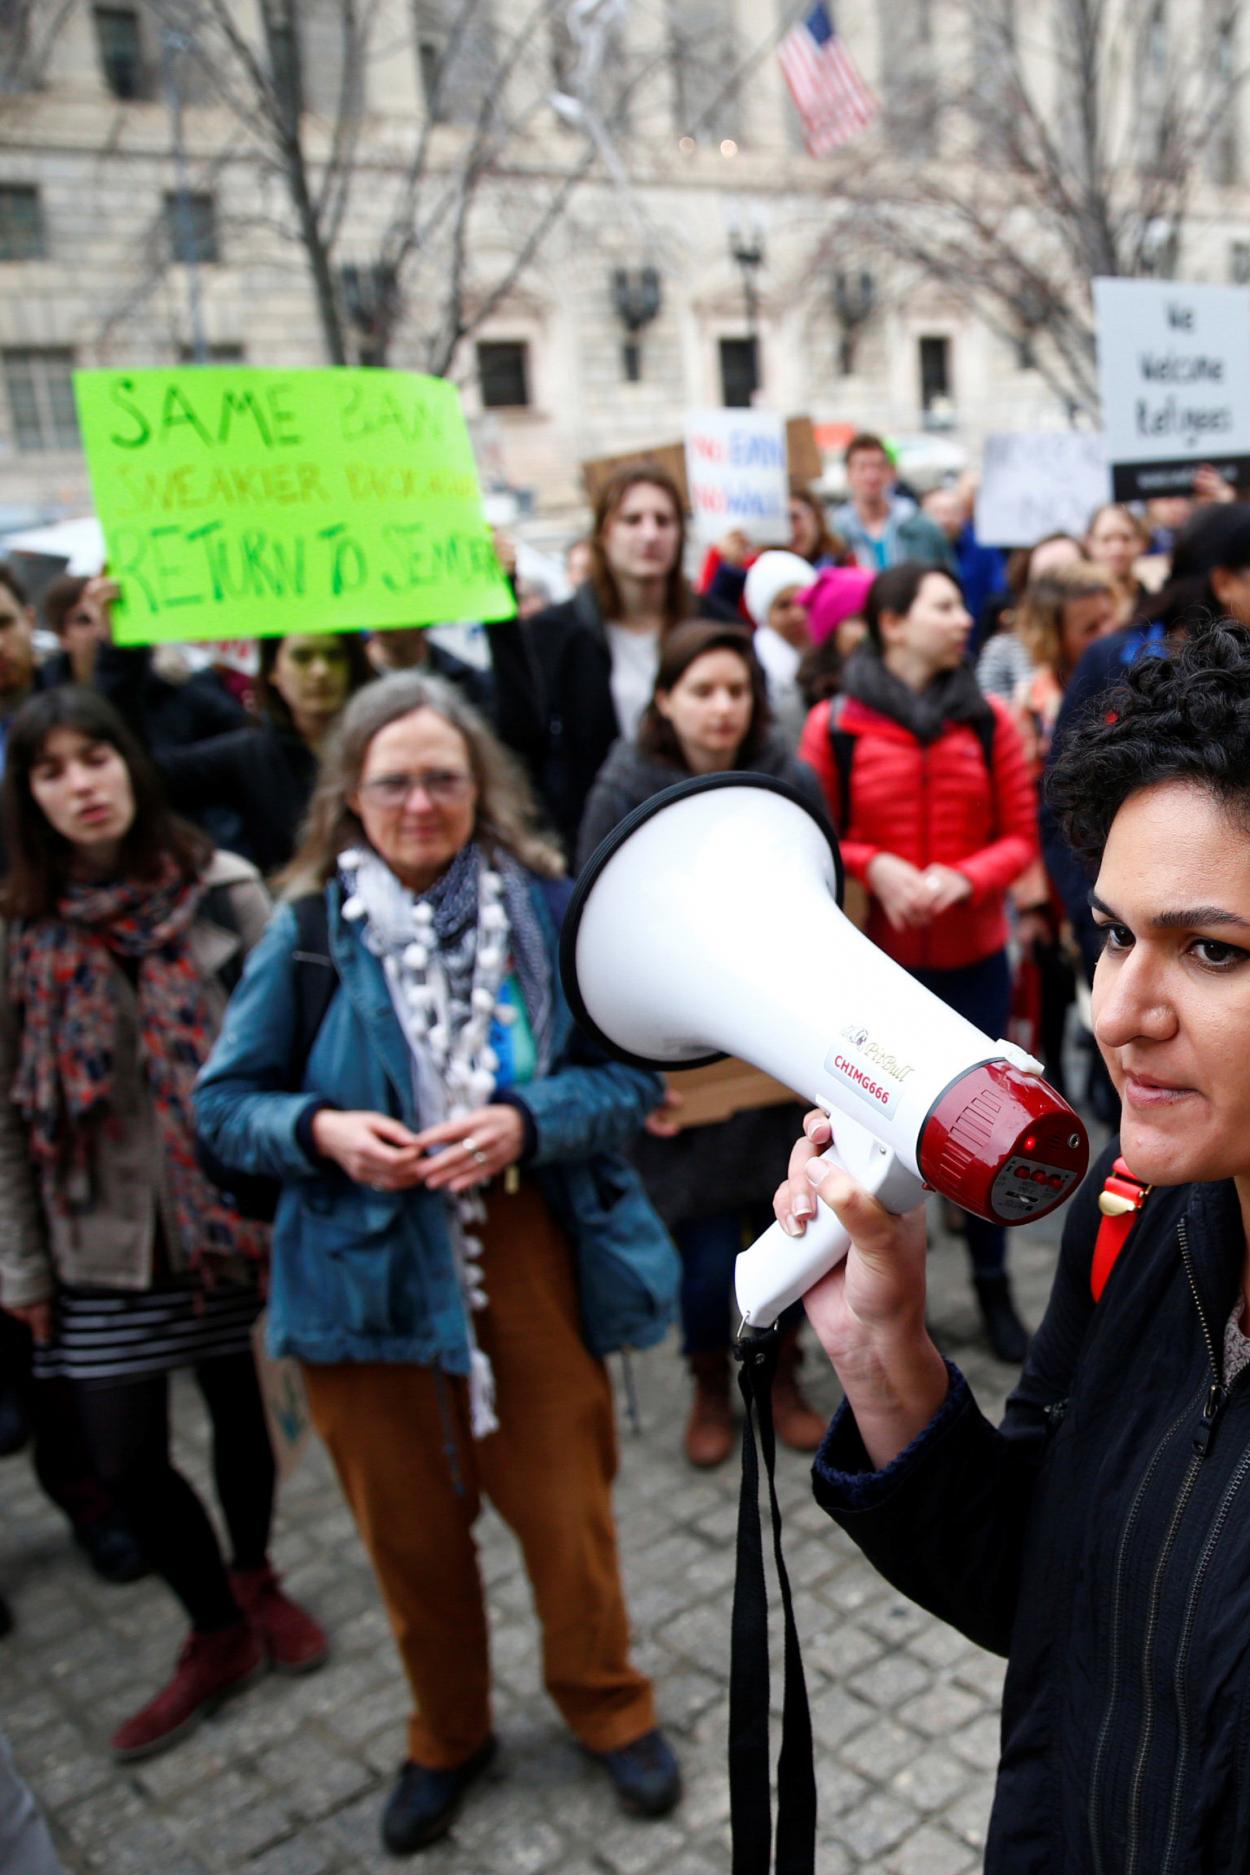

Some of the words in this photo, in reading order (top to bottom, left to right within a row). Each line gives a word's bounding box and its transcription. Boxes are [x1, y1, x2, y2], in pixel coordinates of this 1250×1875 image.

[1164, 303, 1195, 335] We
[1138, 353, 1224, 385] Welcome
[110, 378, 301, 449] SAME
[338, 382, 444, 442] BAN
[1134, 397, 1233, 445] Refugees
[110, 520, 306, 614] RETURN
[319, 522, 367, 597] TO
[834, 1055, 890, 1104] CHIMG666
